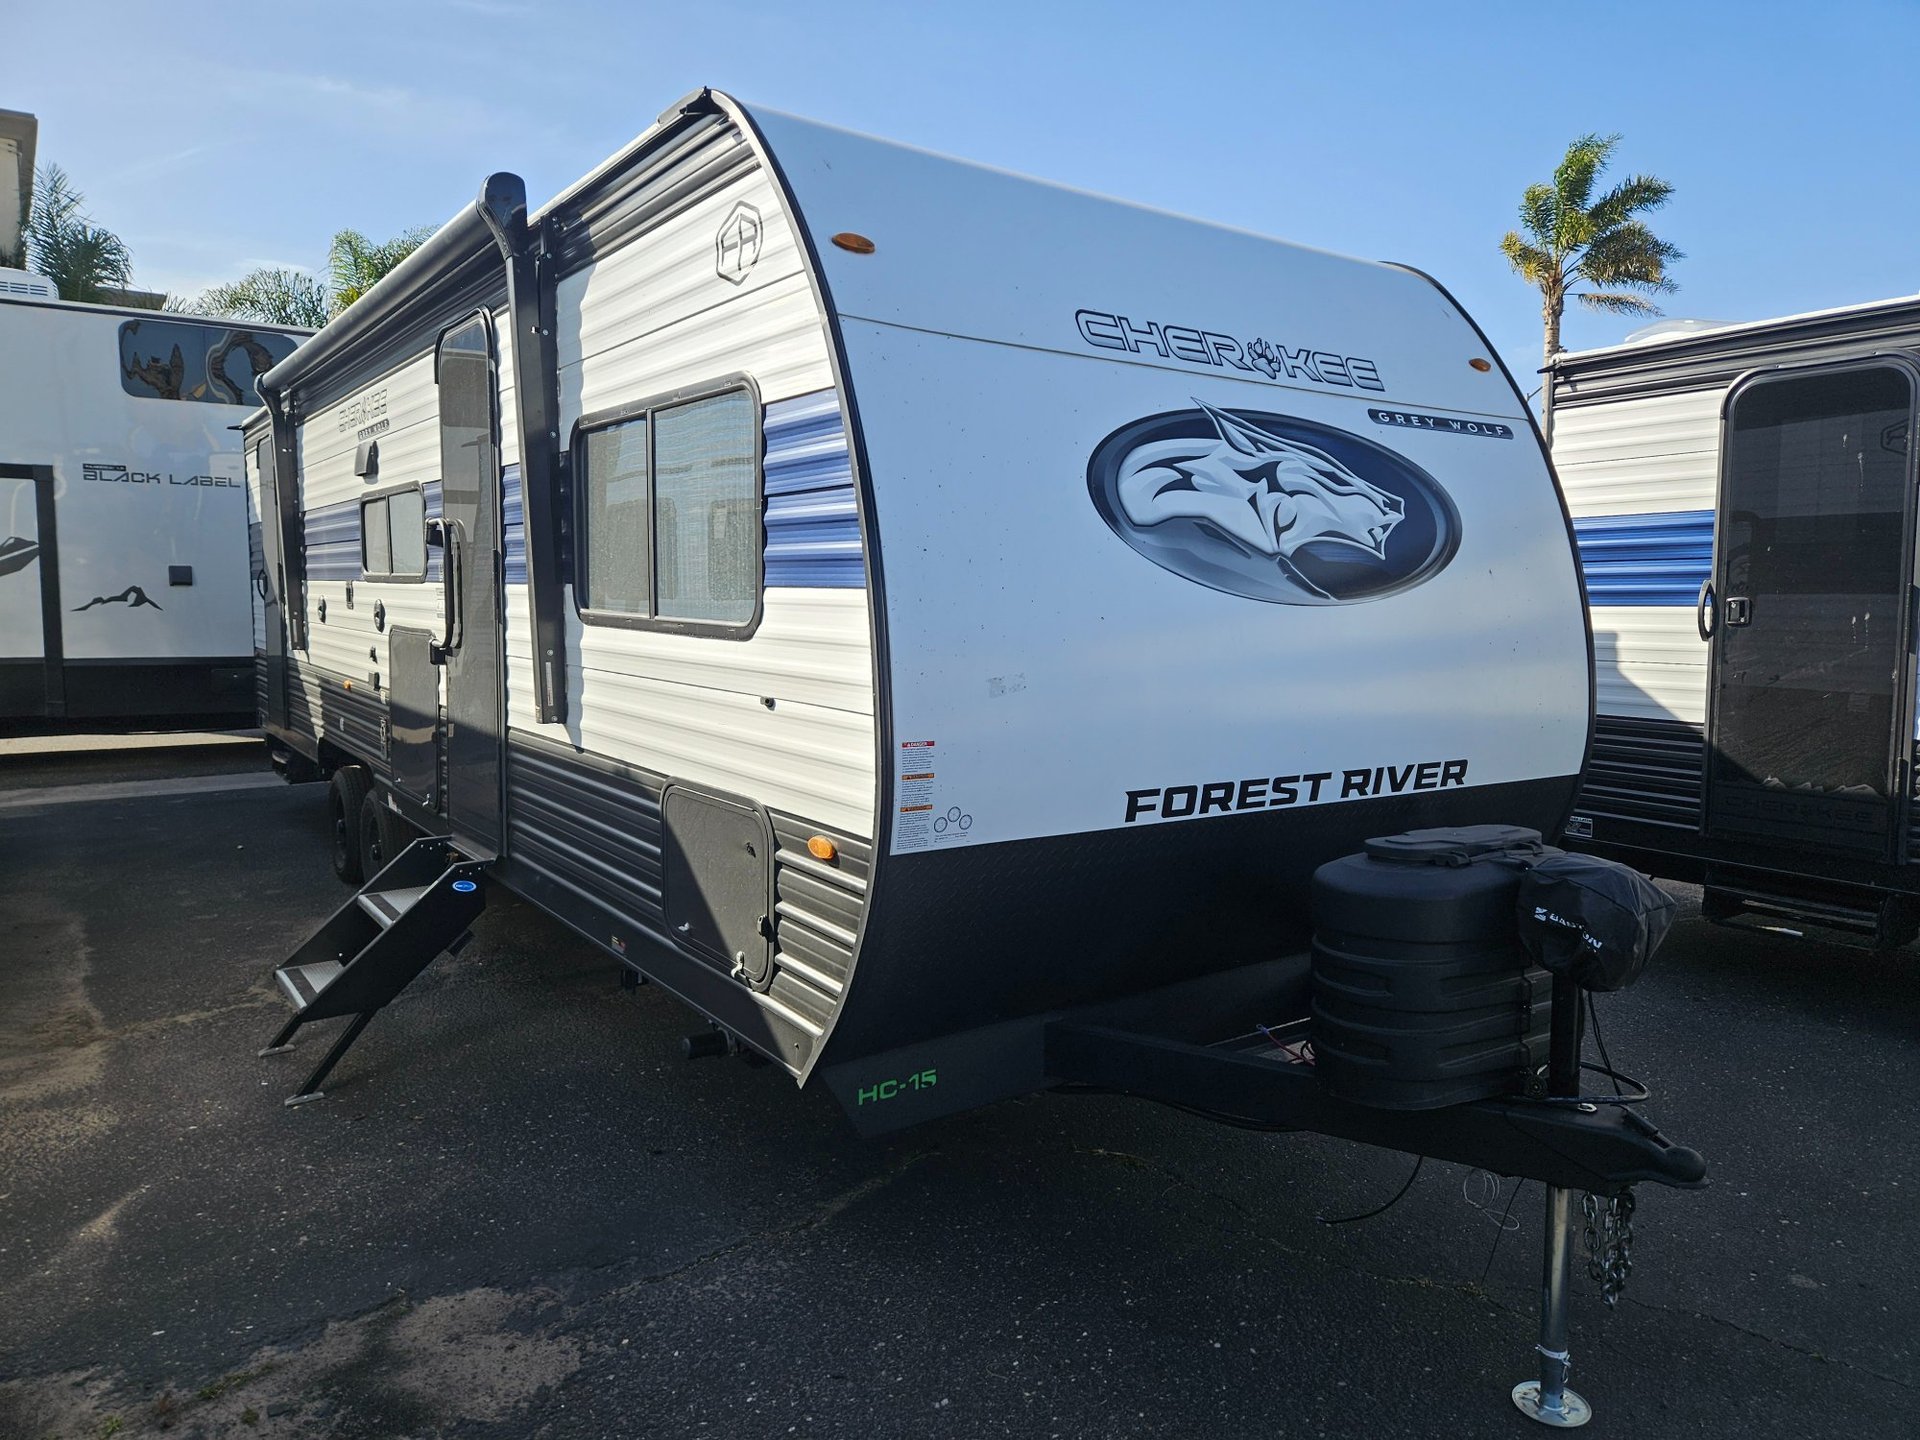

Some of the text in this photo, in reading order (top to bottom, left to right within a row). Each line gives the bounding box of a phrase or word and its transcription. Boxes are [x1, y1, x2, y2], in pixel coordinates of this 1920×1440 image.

[1378, 412, 1503, 436] GREY WOLF
[83, 470, 240, 488] BLACK LABEL
[1125, 759, 1468, 823] FOREST RIVER
[858, 1069, 937, 1105] HC-15
